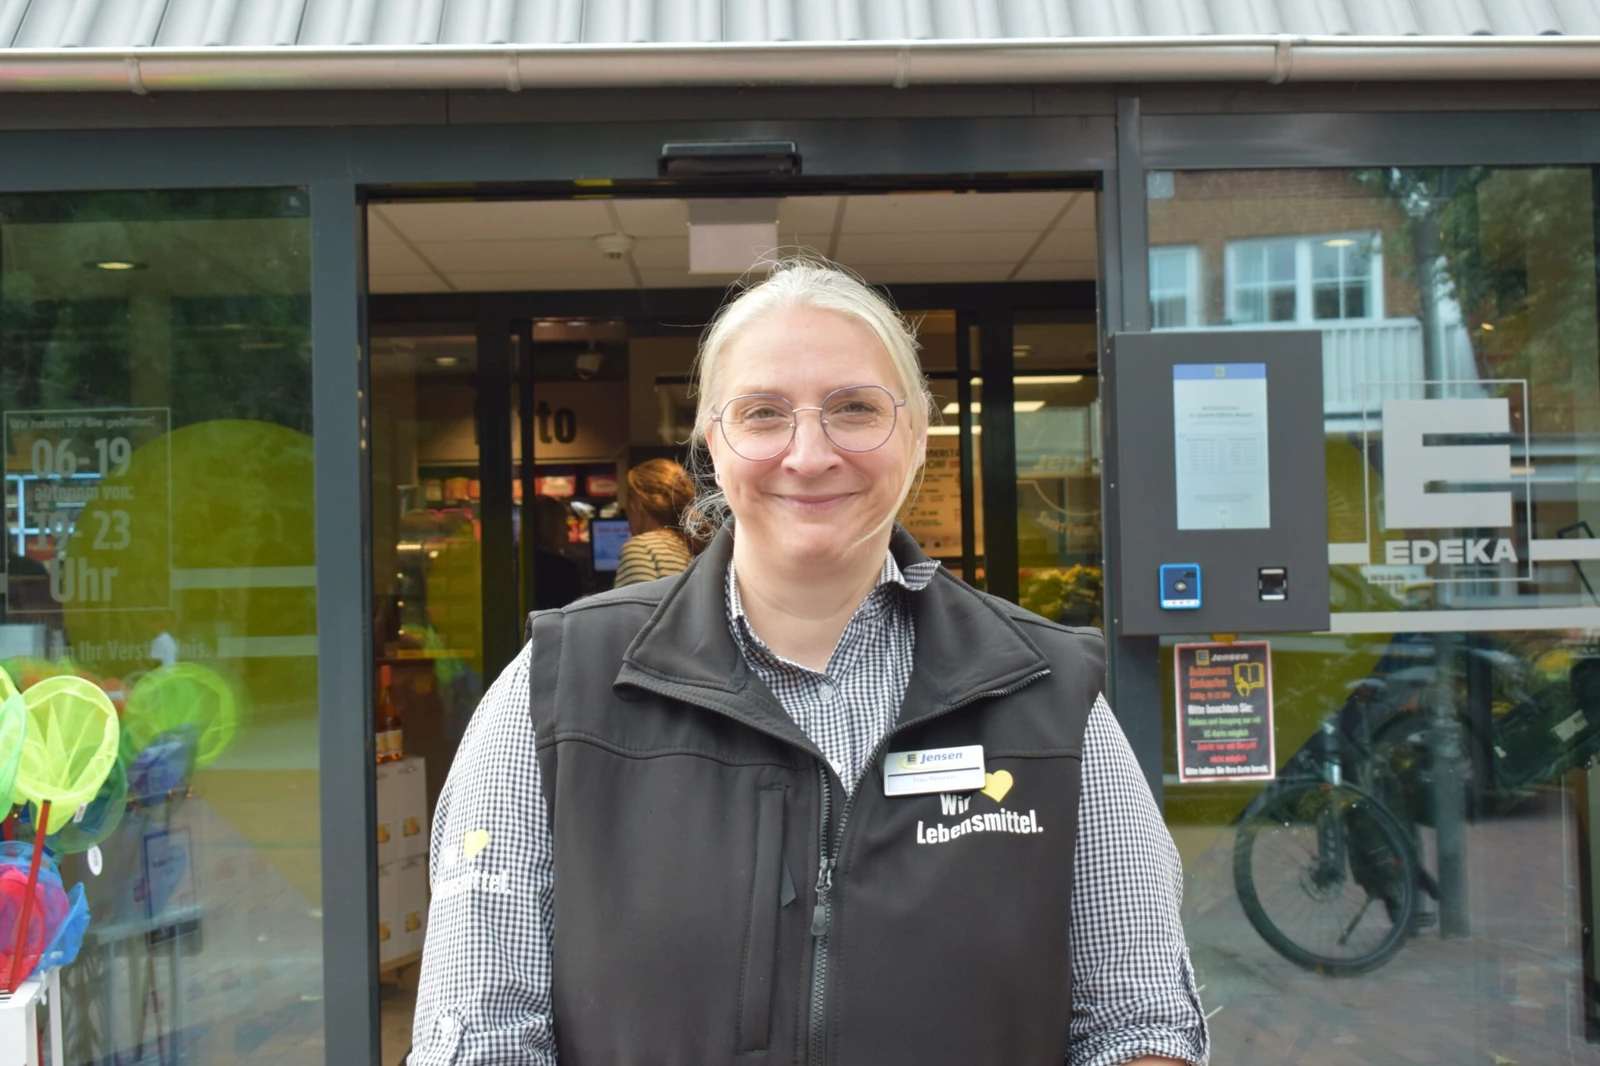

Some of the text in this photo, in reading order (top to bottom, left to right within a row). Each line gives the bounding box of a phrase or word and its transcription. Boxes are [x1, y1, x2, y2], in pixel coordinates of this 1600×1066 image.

[1384, 539, 1519, 565] EDEKA
[51, 557, 118, 603] Uhr
[80, 641, 102, 661] Ihr
[1211, 652, 1250, 662] Jensen
[1188, 704, 1205, 715] Bitte
[1206, 703, 1239, 714] beachten
[920, 752, 963, 764] Jensen
[940, 793, 971, 816] Wir
[916, 808, 1044, 844] Lebensmittel.
